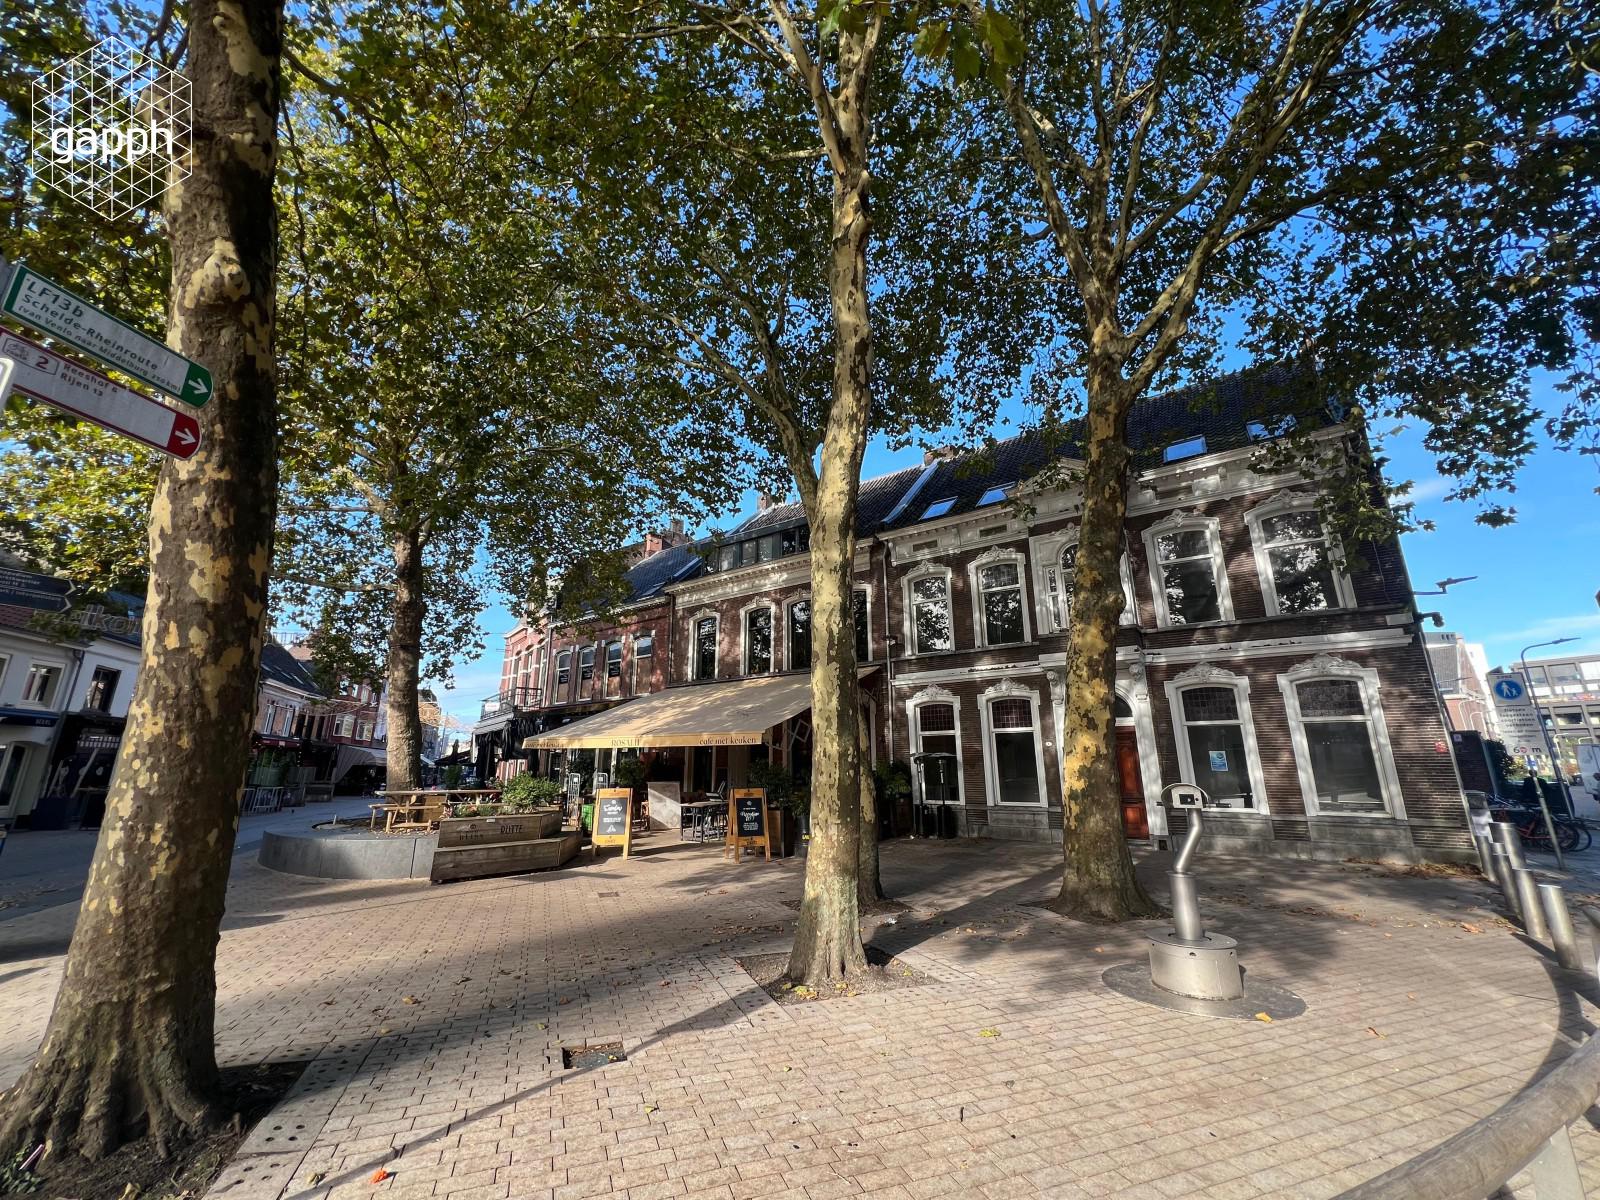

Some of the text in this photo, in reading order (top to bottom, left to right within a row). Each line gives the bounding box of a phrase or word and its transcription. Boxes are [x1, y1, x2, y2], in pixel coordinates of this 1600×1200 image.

[26, 281, 84, 318] LF13b
[22, 294, 159, 370] Schelde-Rheinroute
[44, 316, 72, 336] Venlo
[74, 333, 97, 348] naar
[99, 346, 148, 377] Middelburg
[35, 355, 49, 370] 2
[63, 363, 109, 388] Reeshof
[60, 372, 89, 391] Rijen
